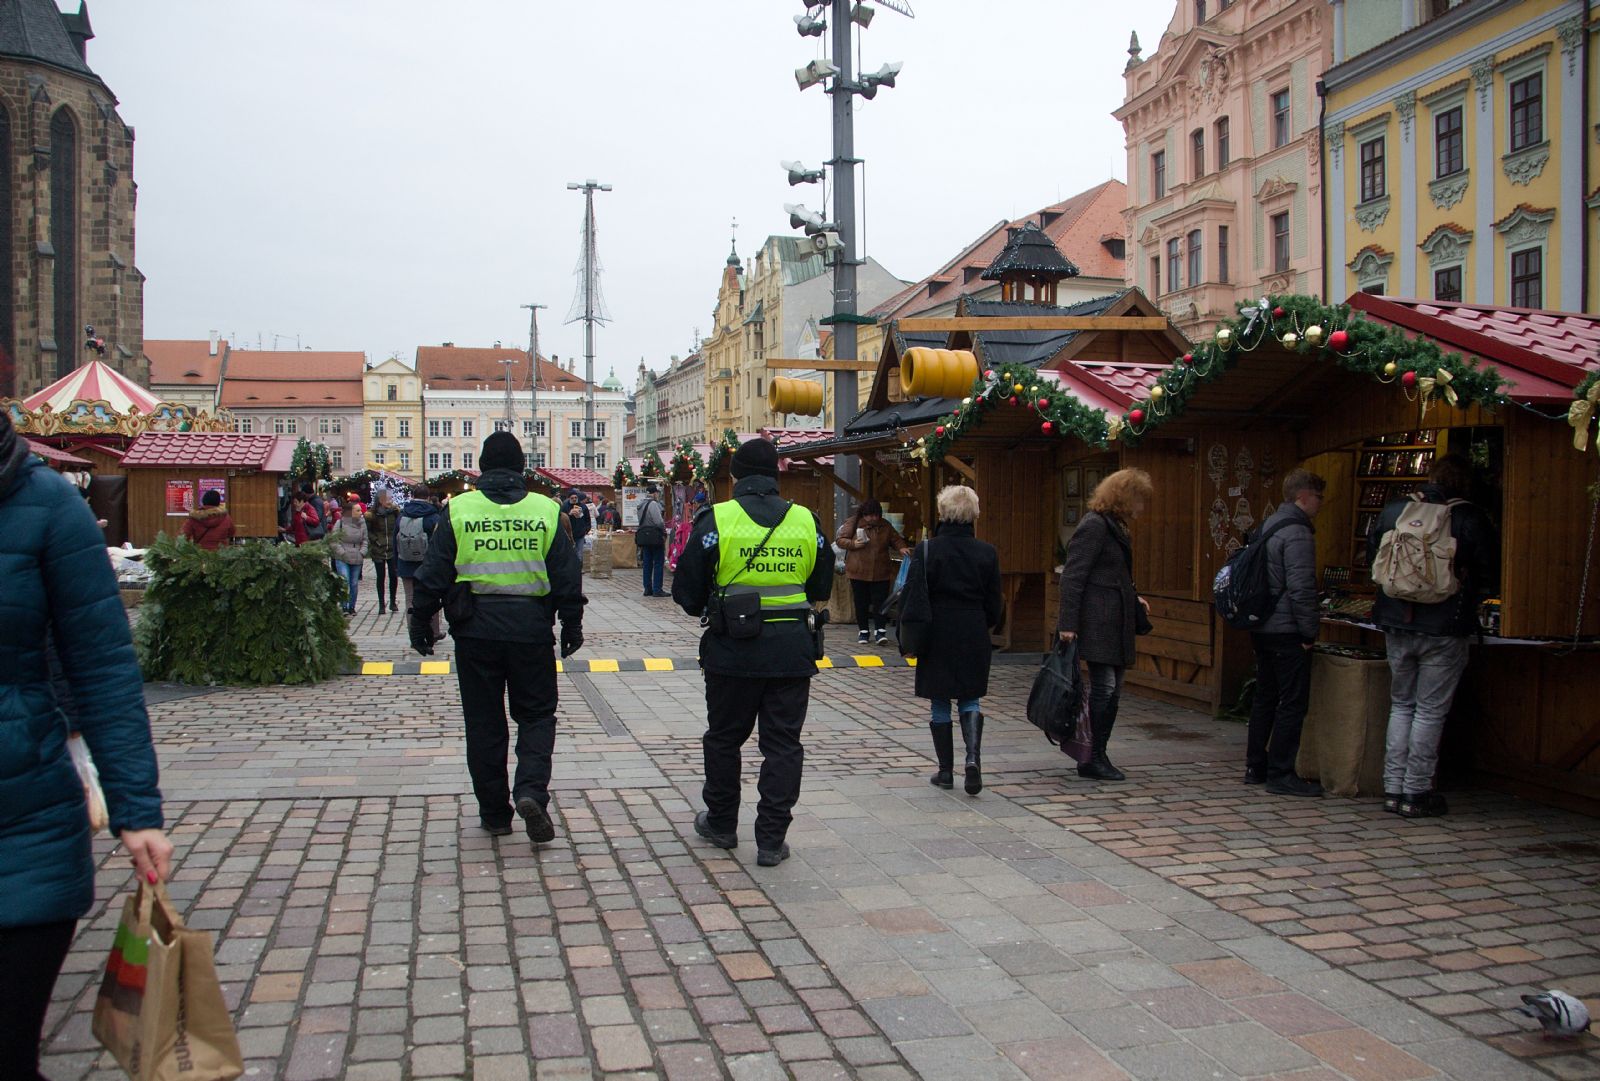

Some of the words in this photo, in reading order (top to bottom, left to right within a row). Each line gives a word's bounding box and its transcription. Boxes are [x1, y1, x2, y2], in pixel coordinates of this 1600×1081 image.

[465, 518, 547, 533] MĚSTSKÁ
[474, 538, 538, 551] POLICIE
[747, 562, 796, 572] POLICIE
